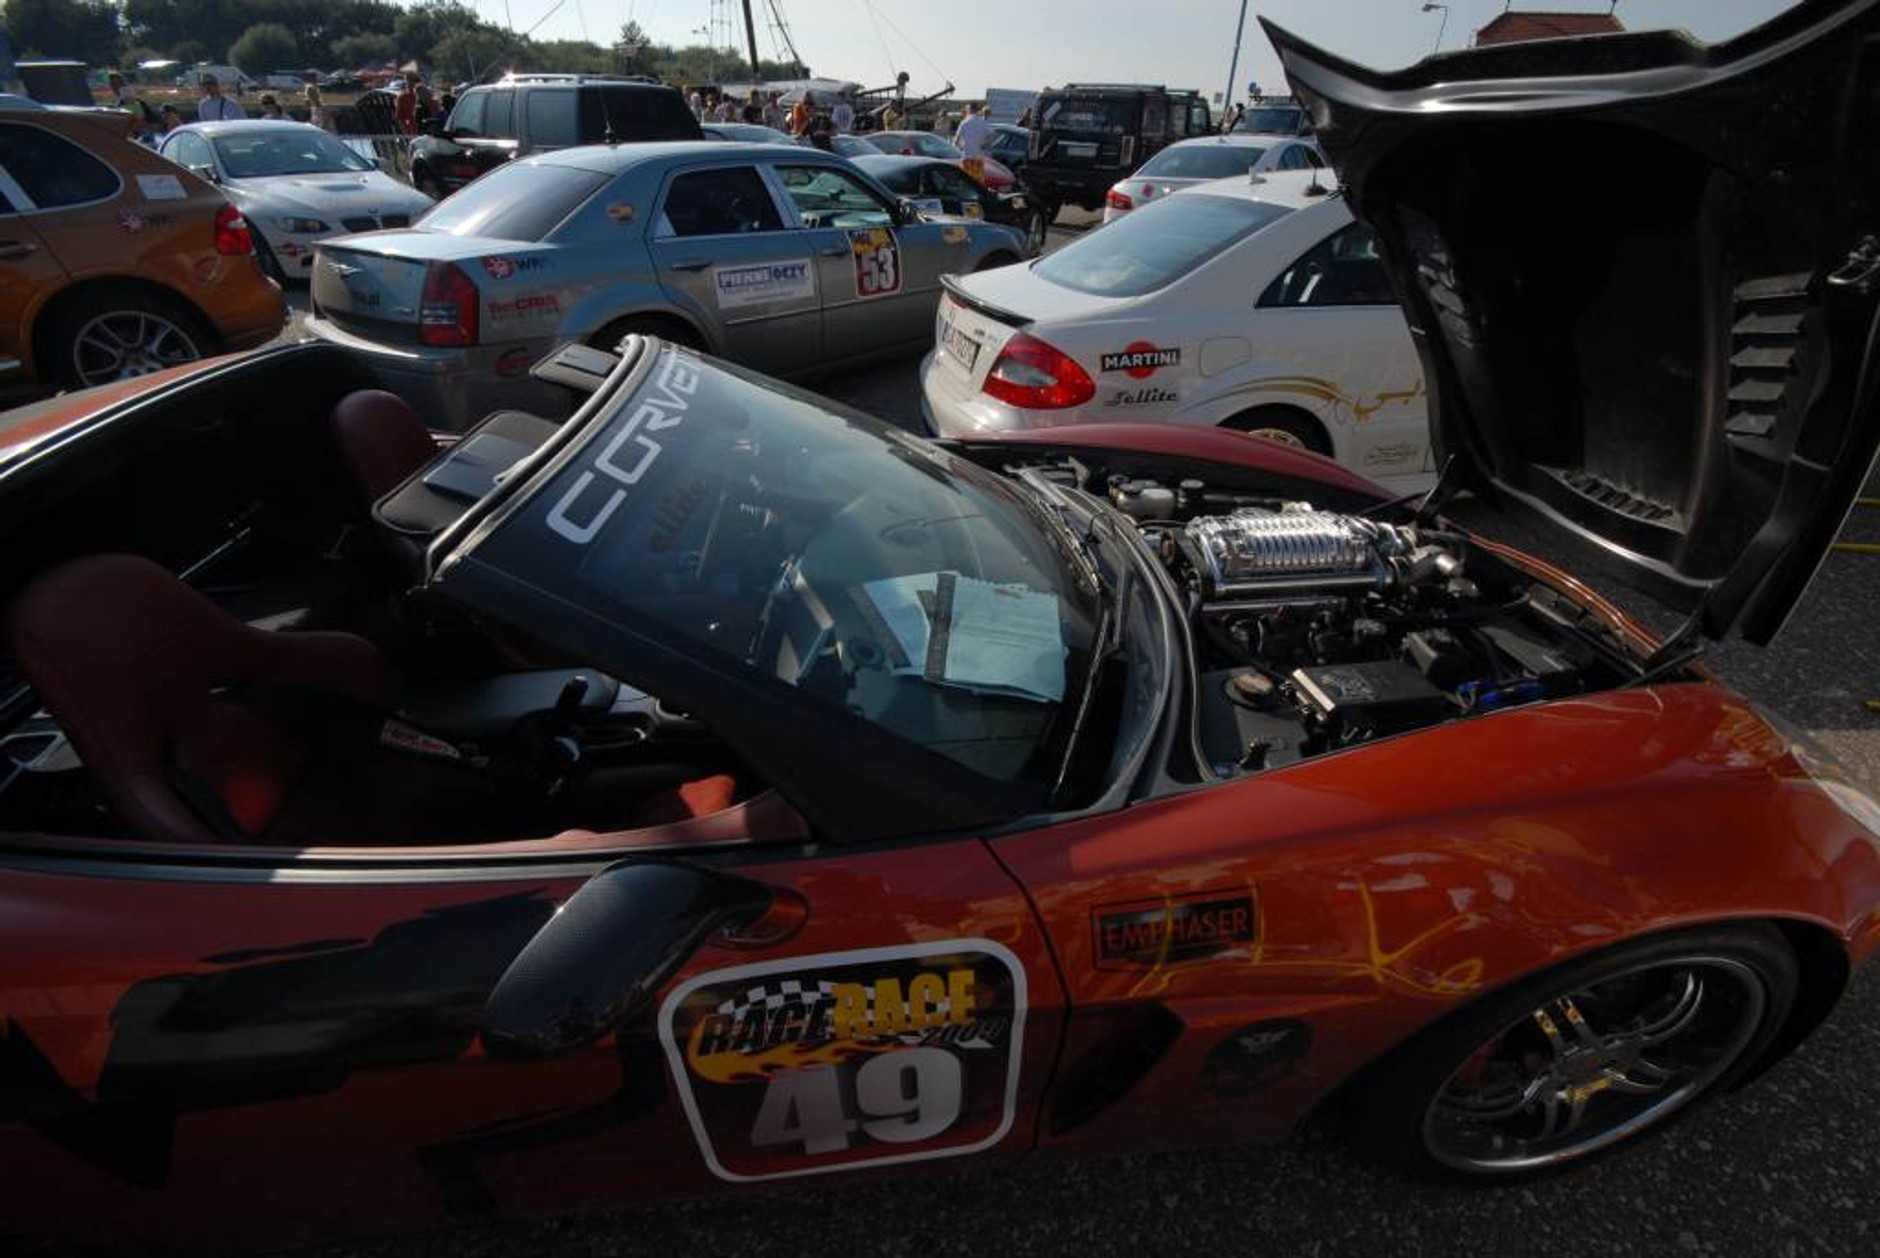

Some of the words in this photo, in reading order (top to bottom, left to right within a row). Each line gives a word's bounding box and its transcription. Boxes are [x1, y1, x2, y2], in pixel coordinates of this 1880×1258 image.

[861, 247, 896, 291] 53
[1104, 350, 1178, 369] MARTINI
[1105, 906, 1249, 951] EMPHASER
[832, 969, 978, 1042] RACE
[750, 1046, 962, 1155] 49
